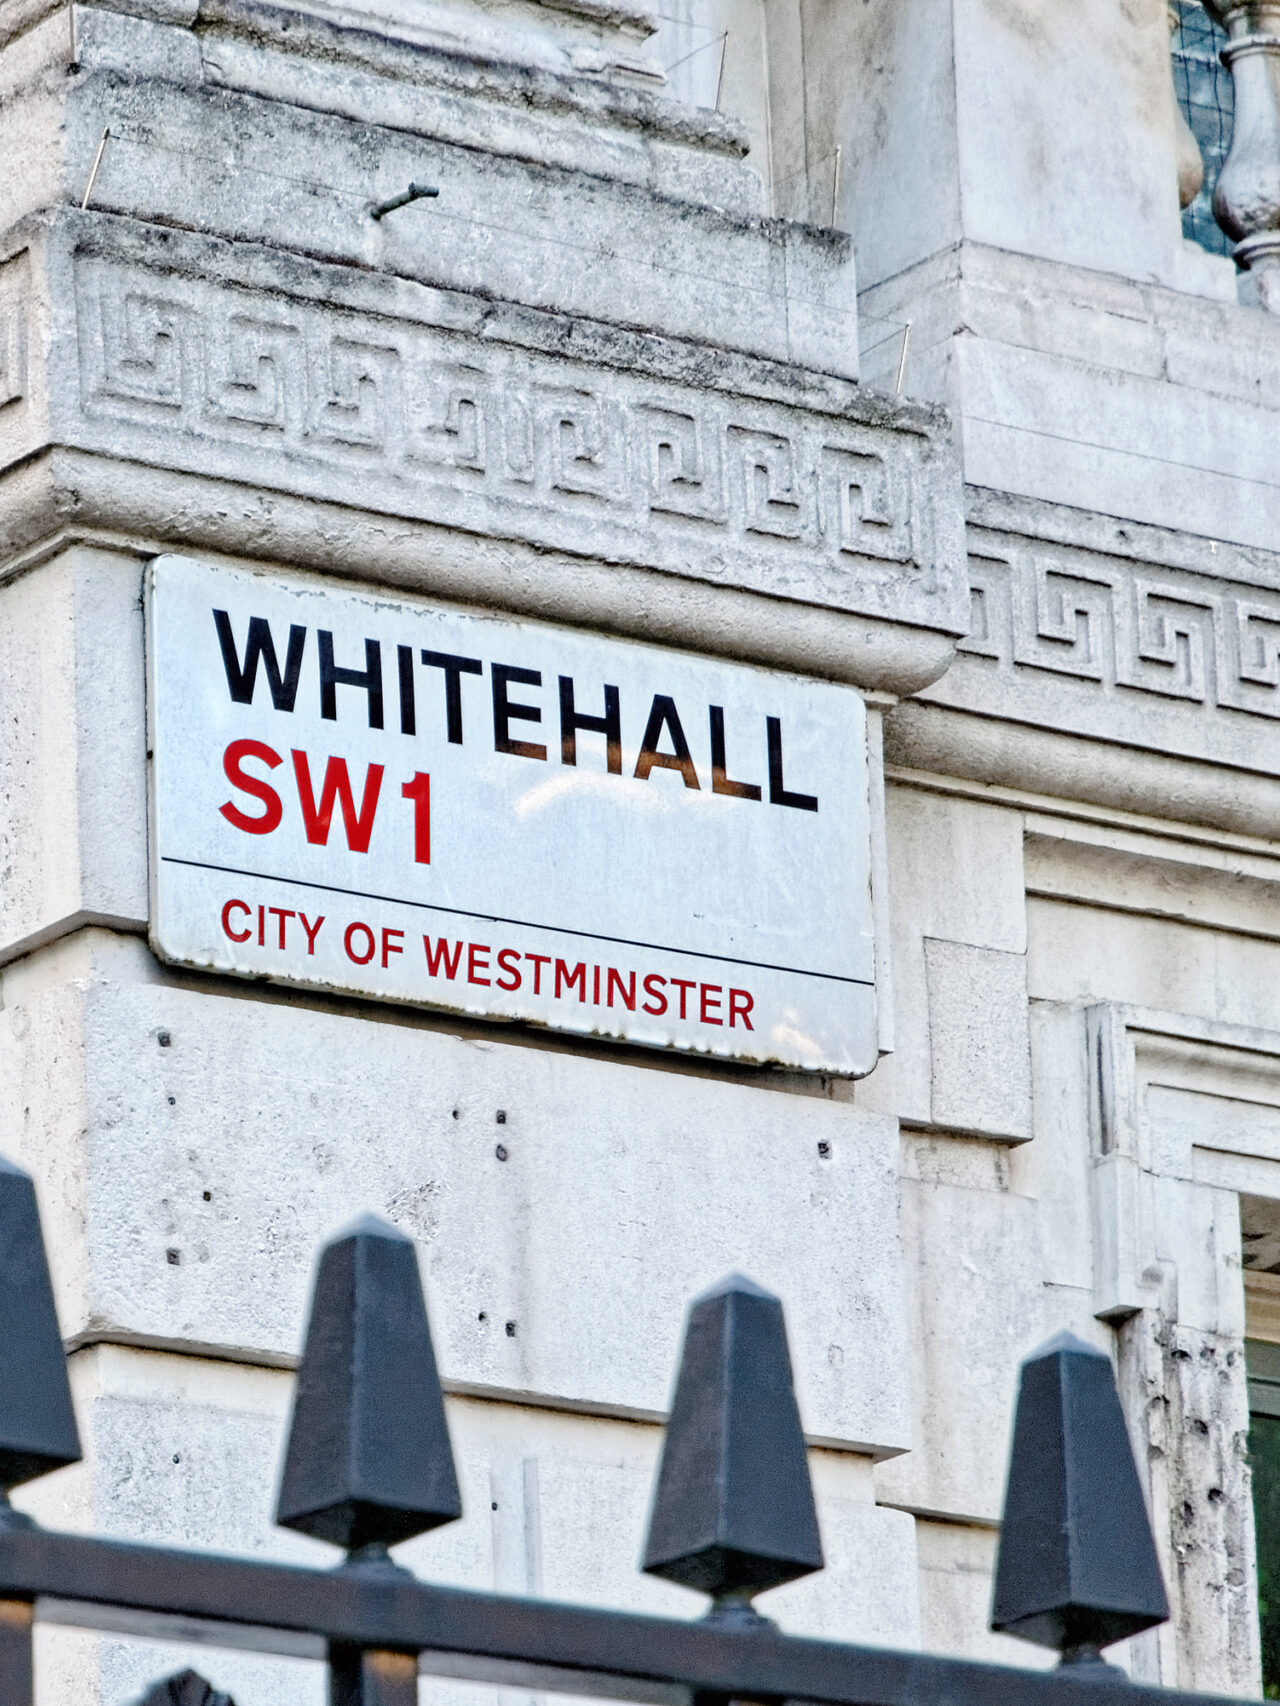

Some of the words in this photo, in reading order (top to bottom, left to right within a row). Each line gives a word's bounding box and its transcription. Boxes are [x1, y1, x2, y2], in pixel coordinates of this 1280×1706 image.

[212, 608, 818, 812] WHITEHALL
[219, 738, 431, 865] SW1
[220, 899, 325, 955] CITY
[344, 921, 405, 969] OF
[423, 935, 755, 1031] WESTMINSTER
